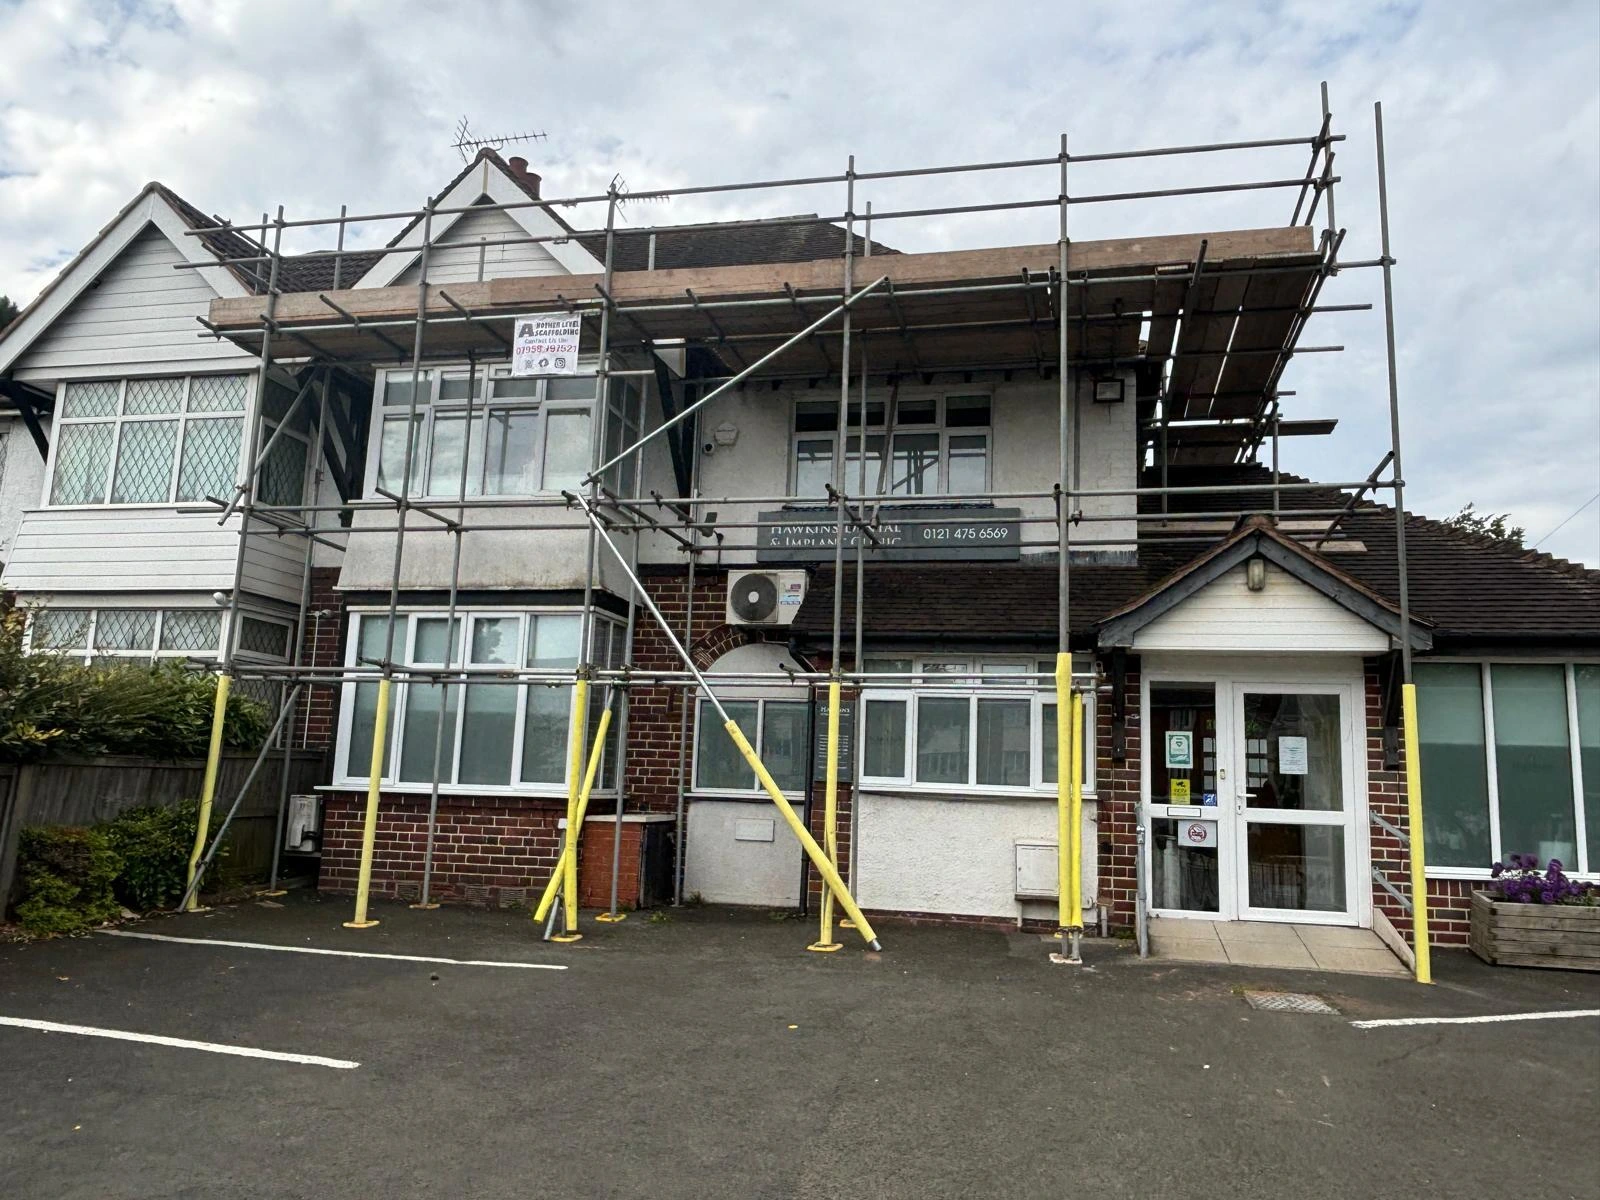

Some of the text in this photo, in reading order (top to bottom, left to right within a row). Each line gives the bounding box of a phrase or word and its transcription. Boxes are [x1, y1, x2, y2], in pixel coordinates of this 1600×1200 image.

[561, 320, 579, 328] LEVEL
[535, 328, 579, 336] SCAFFOLDING
[923, 527, 1009, 540] 0121 475 6569
